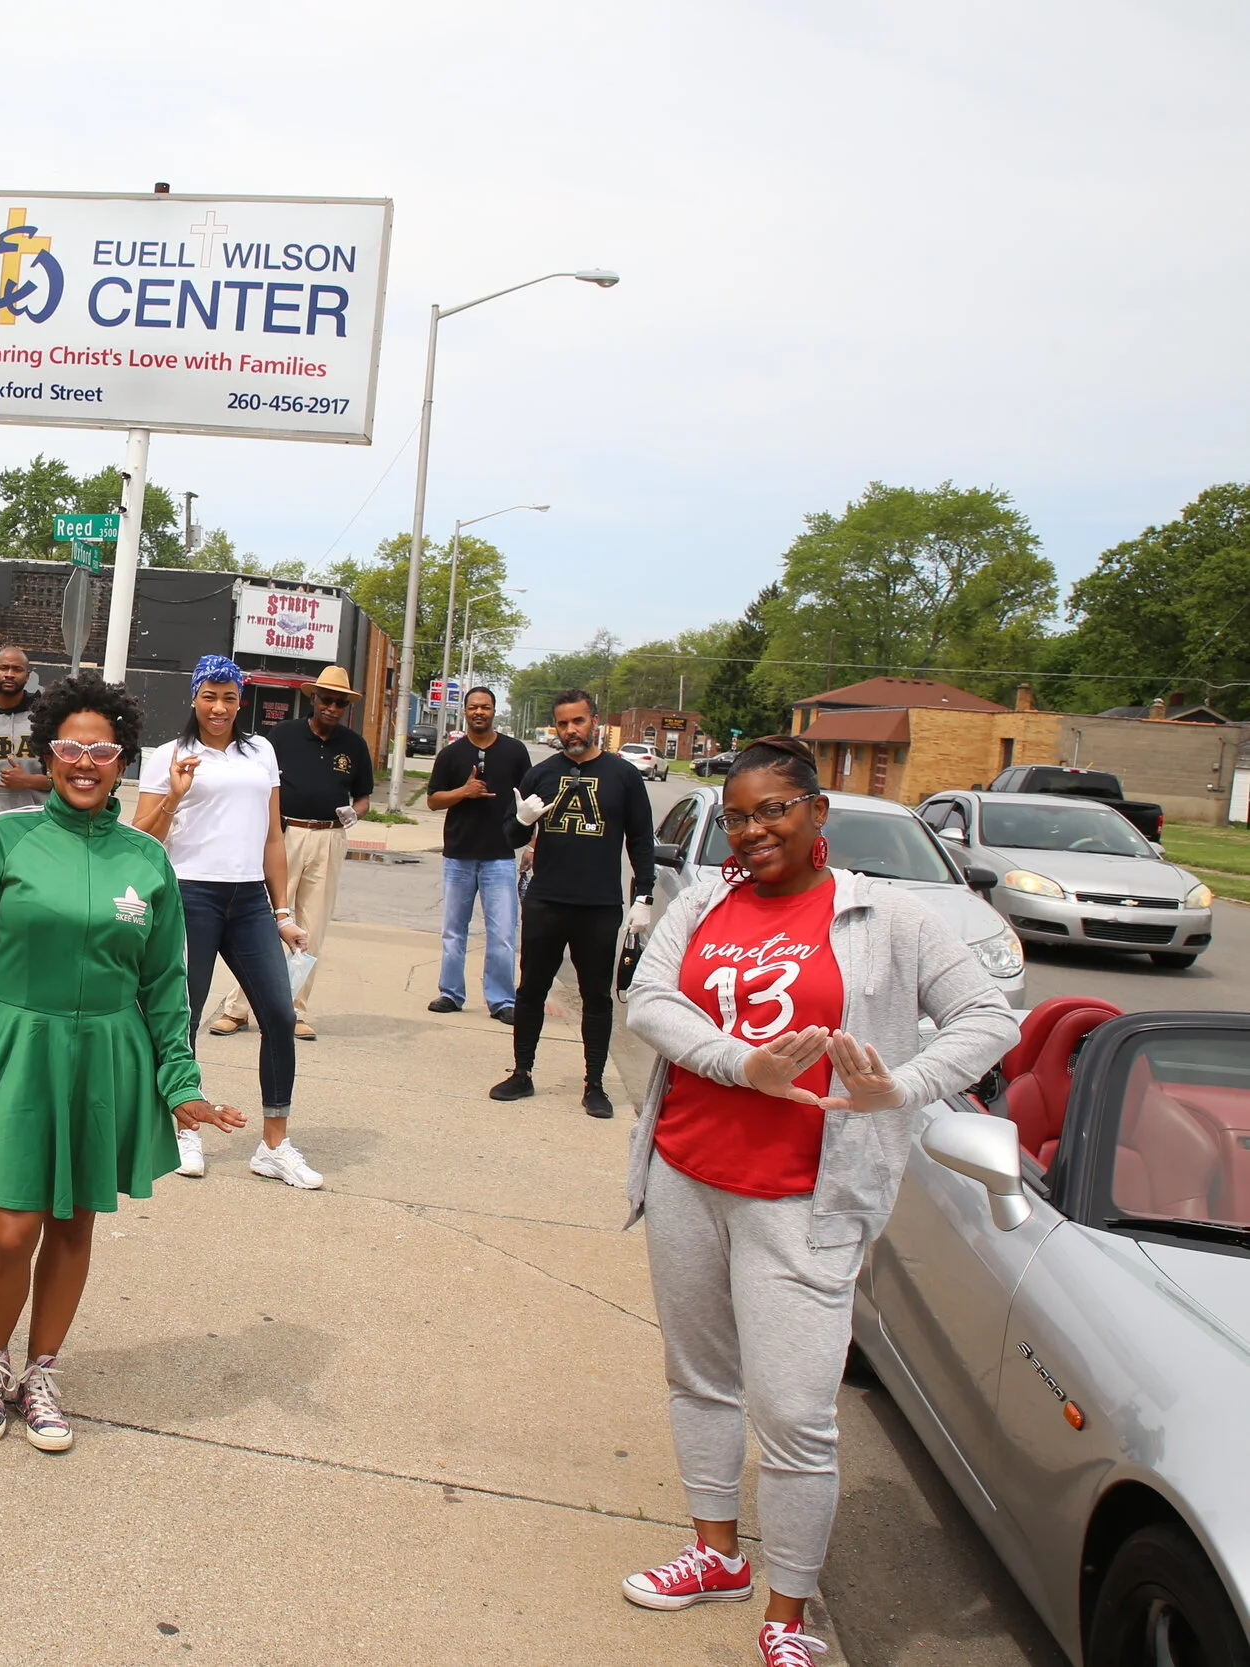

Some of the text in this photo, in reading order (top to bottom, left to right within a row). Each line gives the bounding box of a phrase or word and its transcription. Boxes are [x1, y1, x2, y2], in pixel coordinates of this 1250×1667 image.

[93, 240, 356, 273] EUELL WILSON
[88, 276, 348, 338] CENTER
[49, 346, 123, 367] Christ's
[129, 349, 178, 369] Love
[184, 352, 232, 371] with
[239, 354, 327, 378] Families
[49, 383, 104, 403] Street
[227, 392, 350, 416] 260-456-2917
[57, 517, 113, 537] Reed St
[99, 528, 118, 538] 3500
[545, 776, 606, 837] A
[115, 913, 132, 922] SKEE
[699, 931, 821, 966] nineteen
[703, 960, 801, 1040] 13
[1016, 1342, 1067, 1402] S2000
